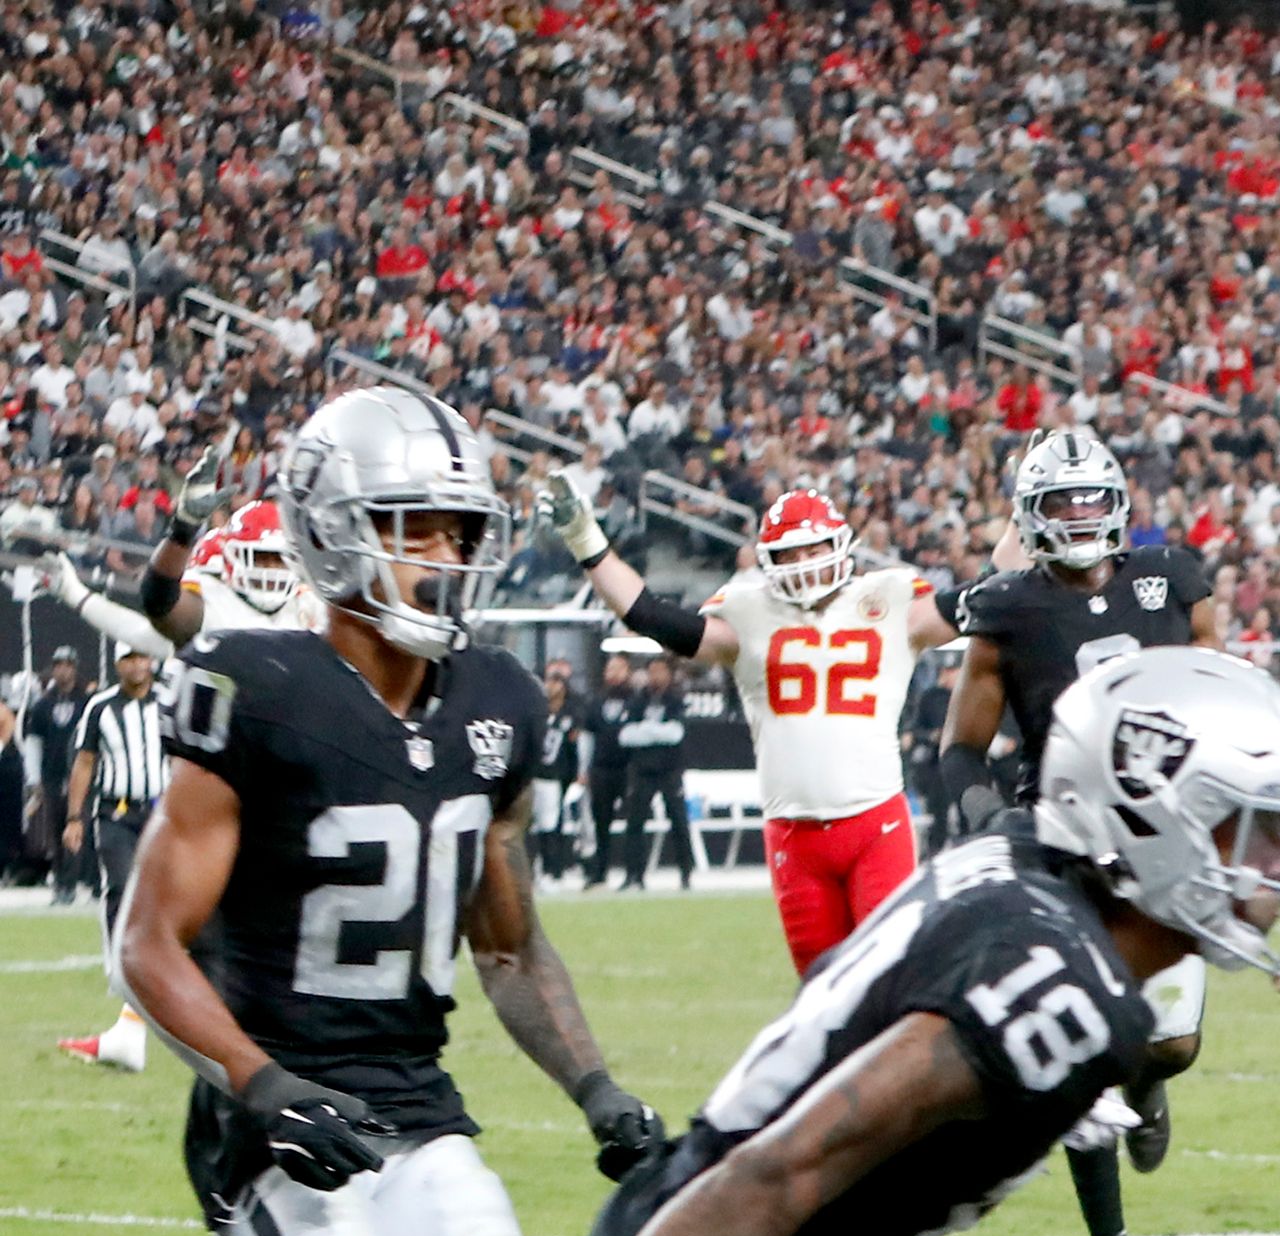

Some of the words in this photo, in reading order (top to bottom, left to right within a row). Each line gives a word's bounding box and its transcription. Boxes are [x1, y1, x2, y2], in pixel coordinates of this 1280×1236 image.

[766, 626, 882, 718] 62
[292, 793, 492, 1000] 20
[965, 944, 1111, 1093] 18
